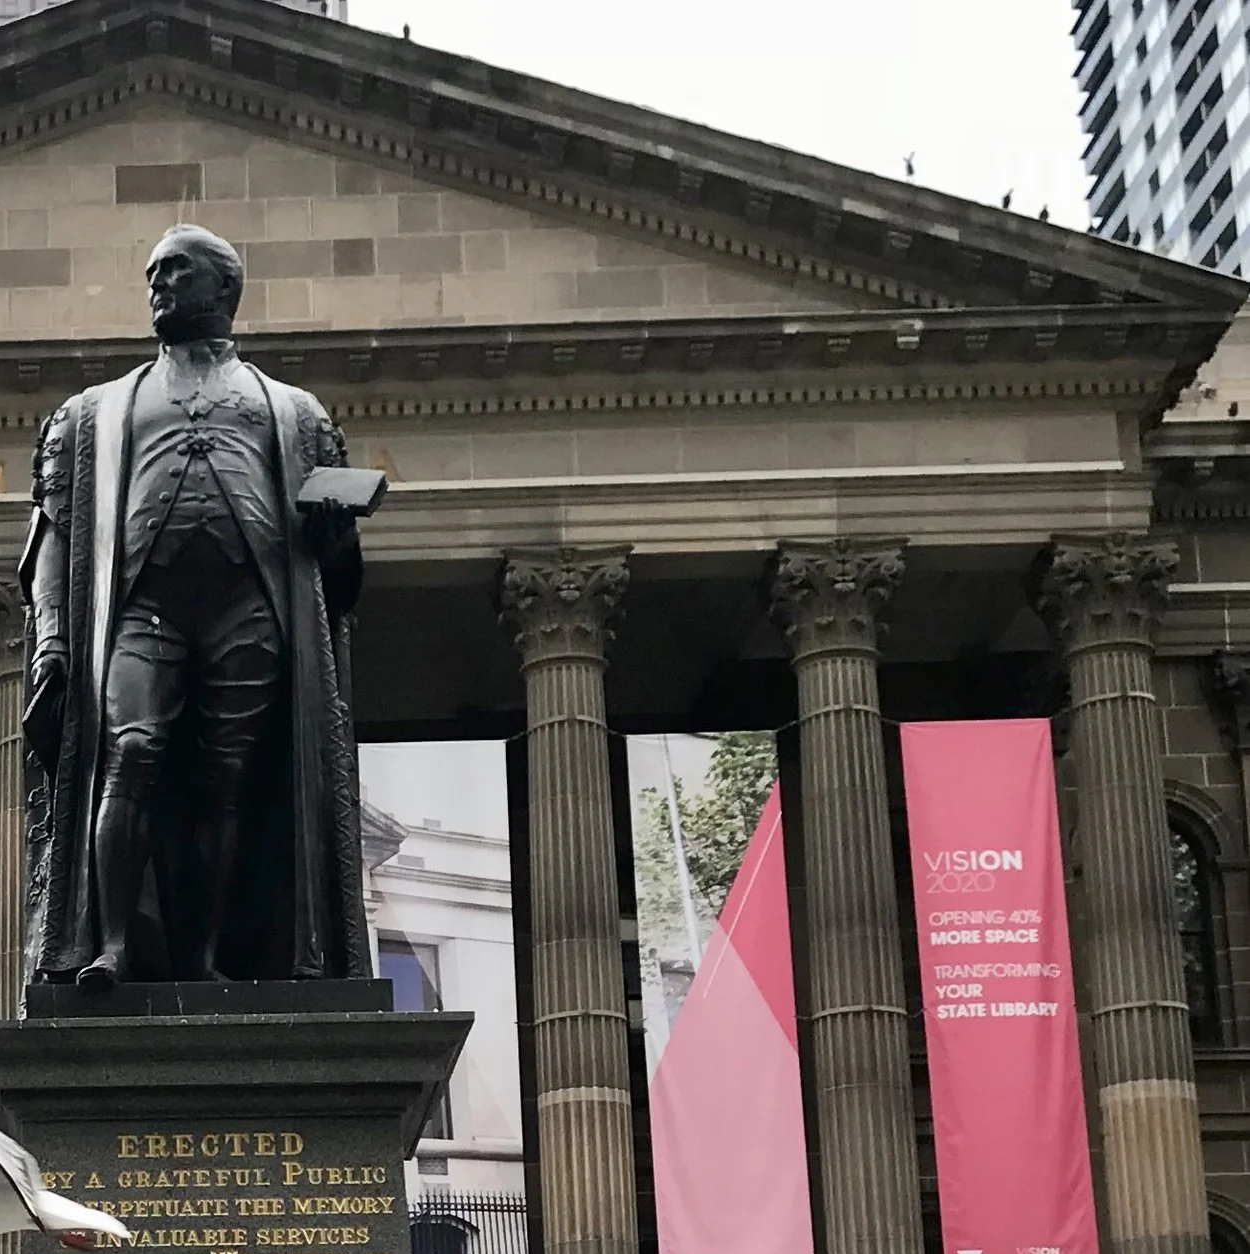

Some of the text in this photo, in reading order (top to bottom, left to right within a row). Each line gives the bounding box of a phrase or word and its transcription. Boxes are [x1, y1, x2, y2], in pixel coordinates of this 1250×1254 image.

[923, 850, 1023, 871] VISION
[926, 872, 996, 894] 2020
[929, 909, 1042, 927] OPENING 40%
[930, 929, 1039, 945] MORE SPACE
[934, 963, 1062, 980] TRANSFORMING
[935, 983, 983, 999] YOUR
[937, 1002, 1059, 1019] STATE LIBRARY
[117, 1132, 304, 1158] ERECTED
[41, 1161, 386, 1189] BY A GRATEFUL PUBLIC
[85, 1197, 395, 1218] RPETUATE THE MEMORY
[93, 1229, 248, 1248] INVALUABLE
[256, 1226, 370, 1246] SERVICES
